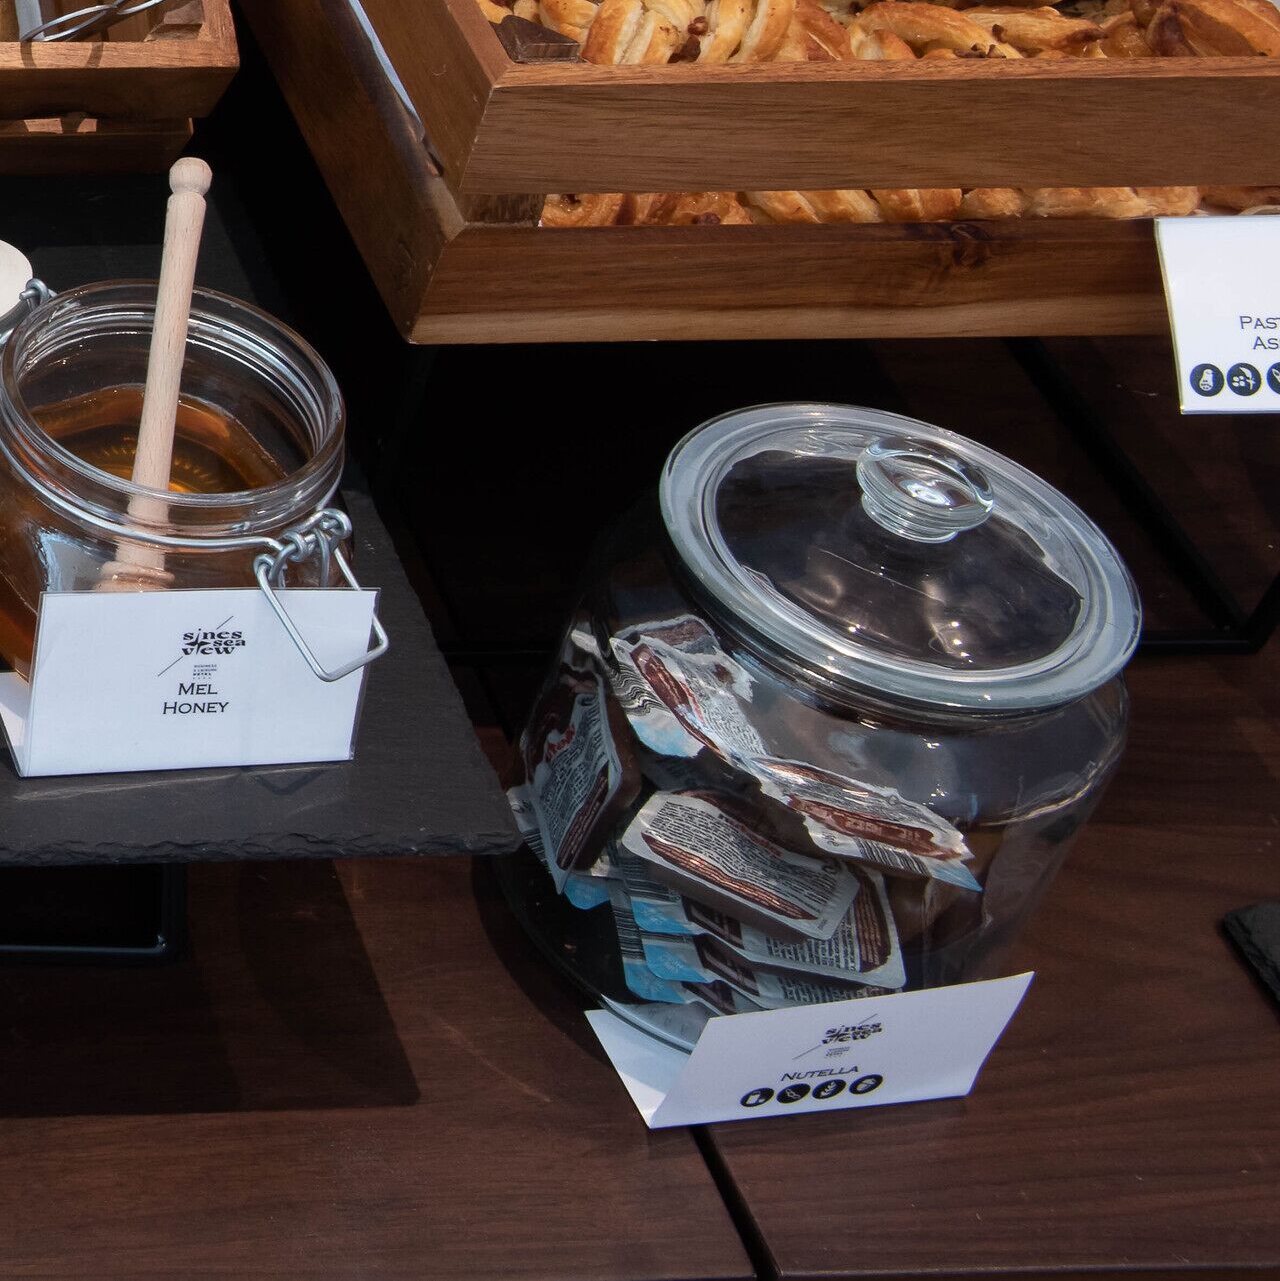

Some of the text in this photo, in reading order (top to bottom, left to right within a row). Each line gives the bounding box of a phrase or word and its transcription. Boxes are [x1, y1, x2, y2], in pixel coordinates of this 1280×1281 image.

[1252, 335, 1280, 350] AS
[177, 682, 218, 696] MEL
[162, 701, 230, 715] HONEY
[780, 1065, 859, 1082] NUTELLA
